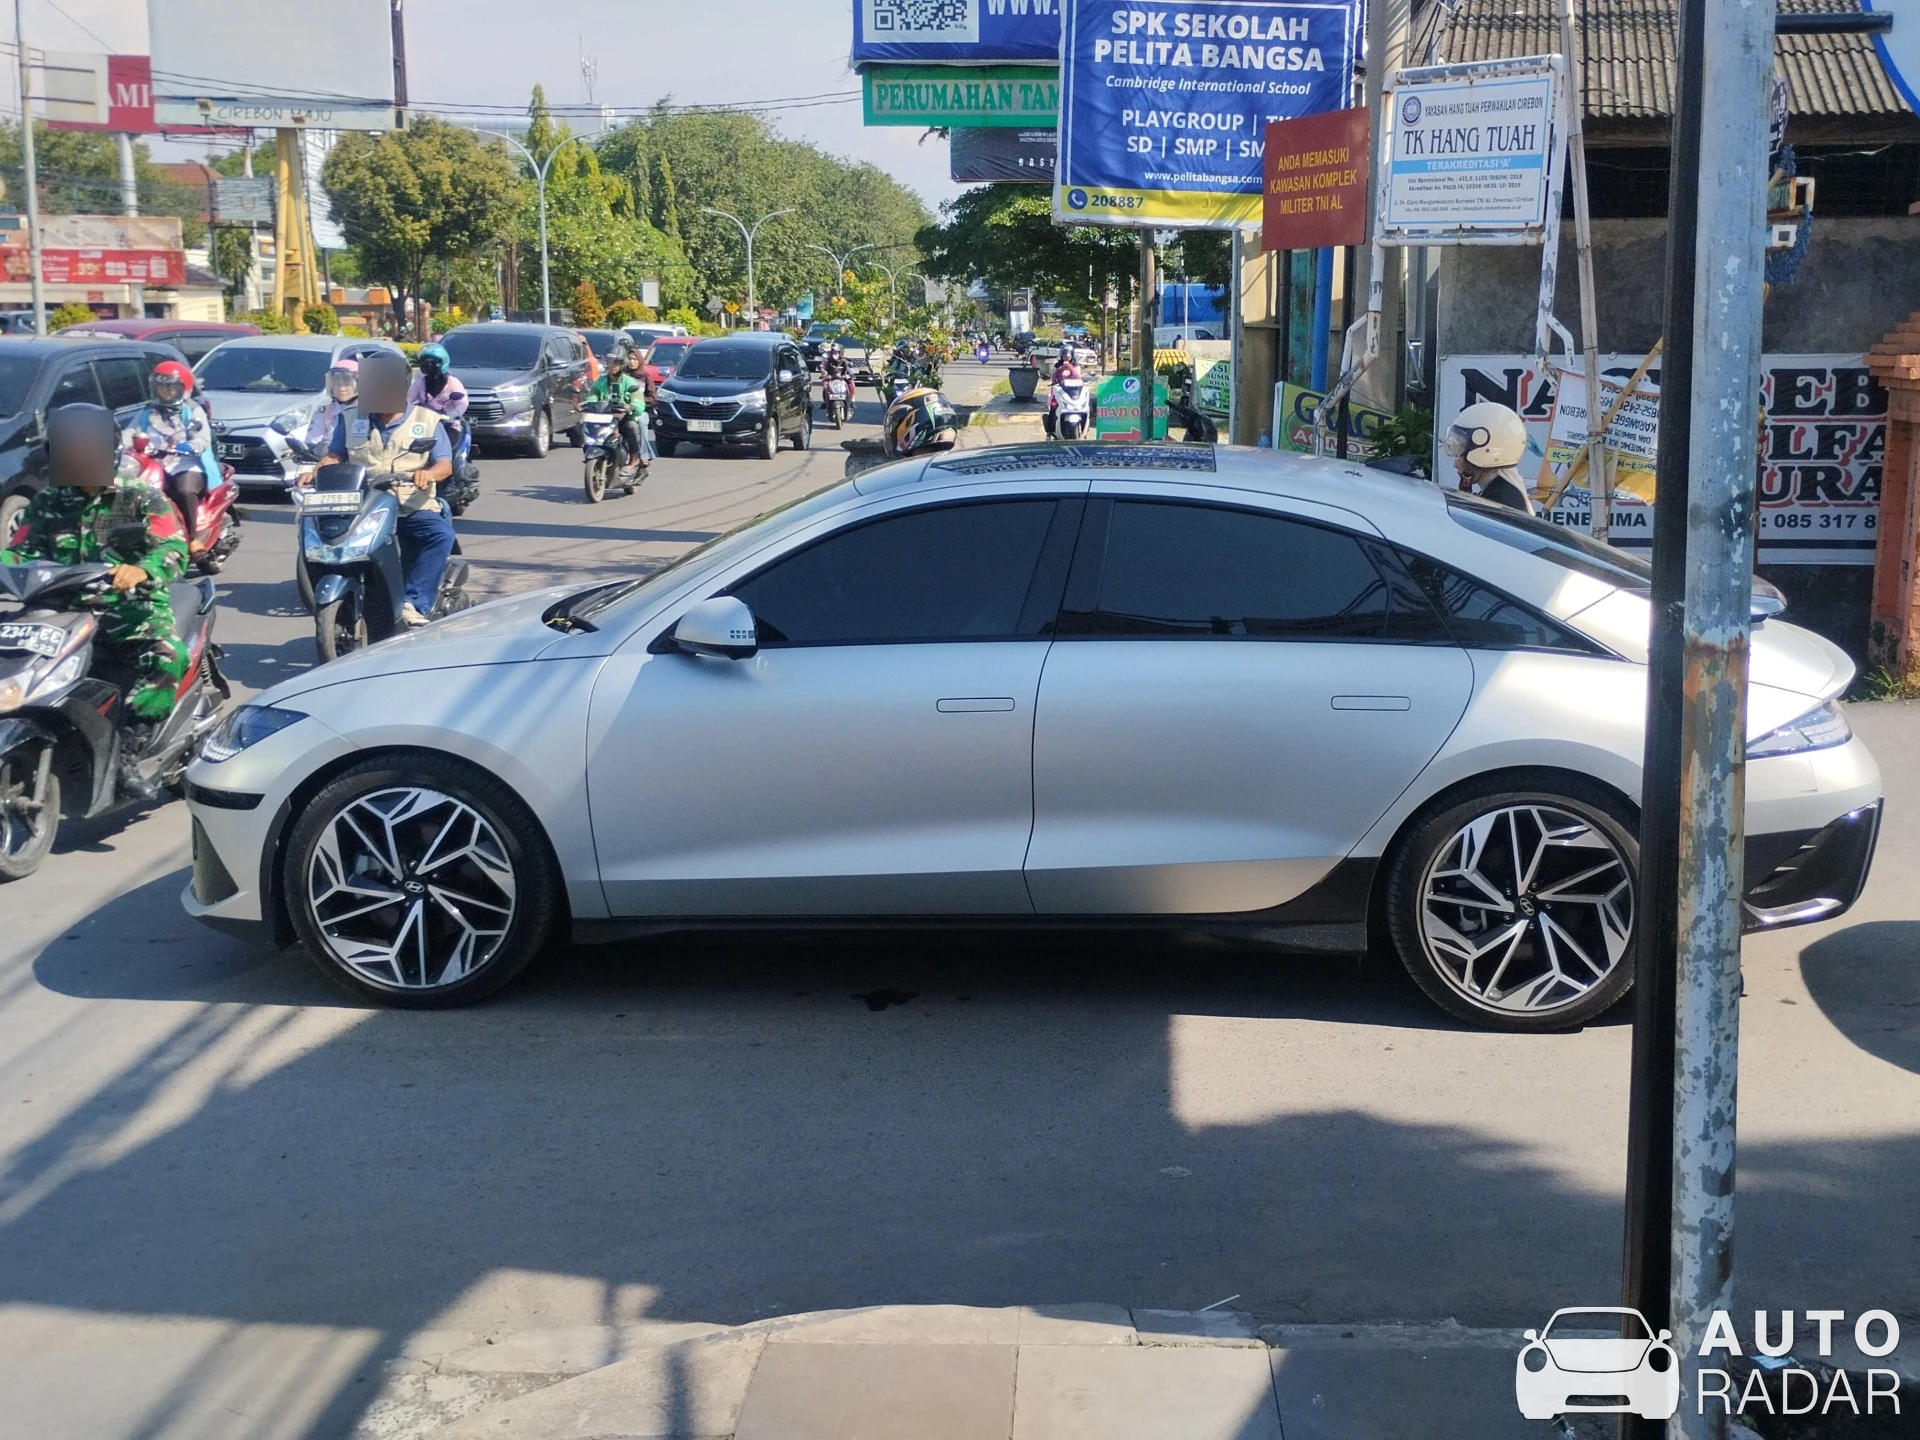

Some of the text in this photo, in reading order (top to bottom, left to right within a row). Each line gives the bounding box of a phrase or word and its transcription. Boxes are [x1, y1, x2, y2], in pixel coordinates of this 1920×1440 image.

[1111, 10, 1309, 41] SPK SEKOLAH
[1094, 39, 1324, 72] PELITA BANGSA
[1105, 75, 1311, 95] Cambridge International School
[875, 83, 1014, 111] PERUMAHAN
[1424, 97, 1543, 117] YAYASAN HANG TUAH PERWAKILAN CIREBON
[217, 106, 283, 120] CIREBON
[1122, 110, 1244, 131] PLAYGROUP
[1127, 136, 1153, 153] SD
[1174, 138, 1217, 156] SMP
[1403, 124, 1536, 154] TK HANG TUAH
[1277, 147, 1350, 171] ANDA MEMASUKI
[1426, 159, 1498, 171] TERAKREDITASI
[1144, 172, 1263, 185] www.pelitabangsa.com
[1270, 169, 1358, 194] KAWASAN KOMPLEK
[1091, 194, 1144, 208] 208887
[1280, 194, 1343, 214] MILITER TNI AL
[1763, 424, 1886, 461] LFA
[1536, 511, 1648, 527] MENEIMA
[1774, 513, 1812, 528] 085
[1819, 513, 1857, 528] 317
